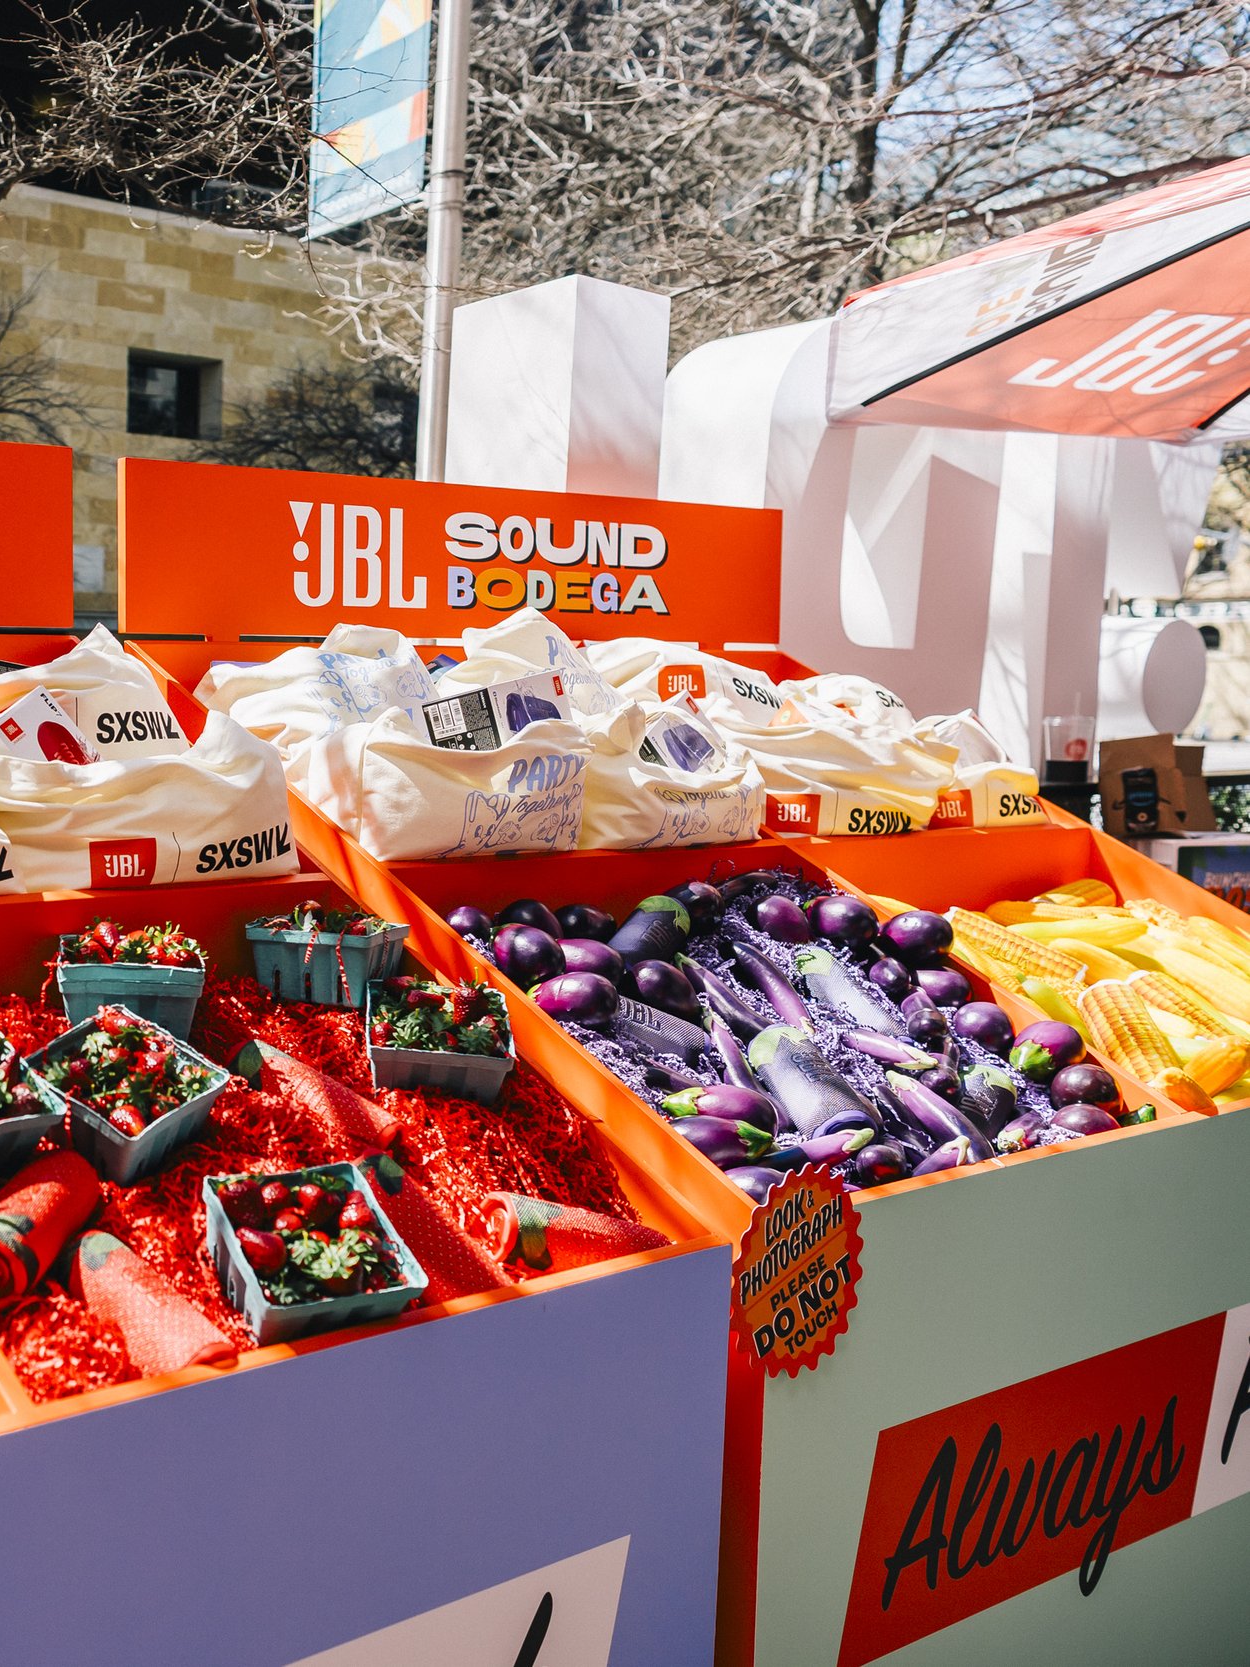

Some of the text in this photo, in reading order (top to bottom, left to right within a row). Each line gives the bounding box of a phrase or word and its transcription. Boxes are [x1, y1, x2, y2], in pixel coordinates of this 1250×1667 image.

[289, 500, 427, 609] JBL
[445, 511, 669, 568] SOUND
[447, 565, 670, 616] BODEGA
[668, 674, 698, 692] JBL
[96, 710, 164, 744] SXSW
[507, 753, 585, 793] PARTY
[778, 803, 900, 835] JBL SXSW
[937, 800, 967, 819] JBL
[104, 828, 274, 878] JBL SXSW
[764, 1188, 814, 1247] LOOK &
[739, 1194, 843, 1305] PHOTOGRAPH
[752, 1252, 851, 1359] DO NOT
[770, 1254, 827, 1312] PLEASE
[784, 1301, 839, 1355] TOUCH
[881, 1395, 1185, 1612] Always
